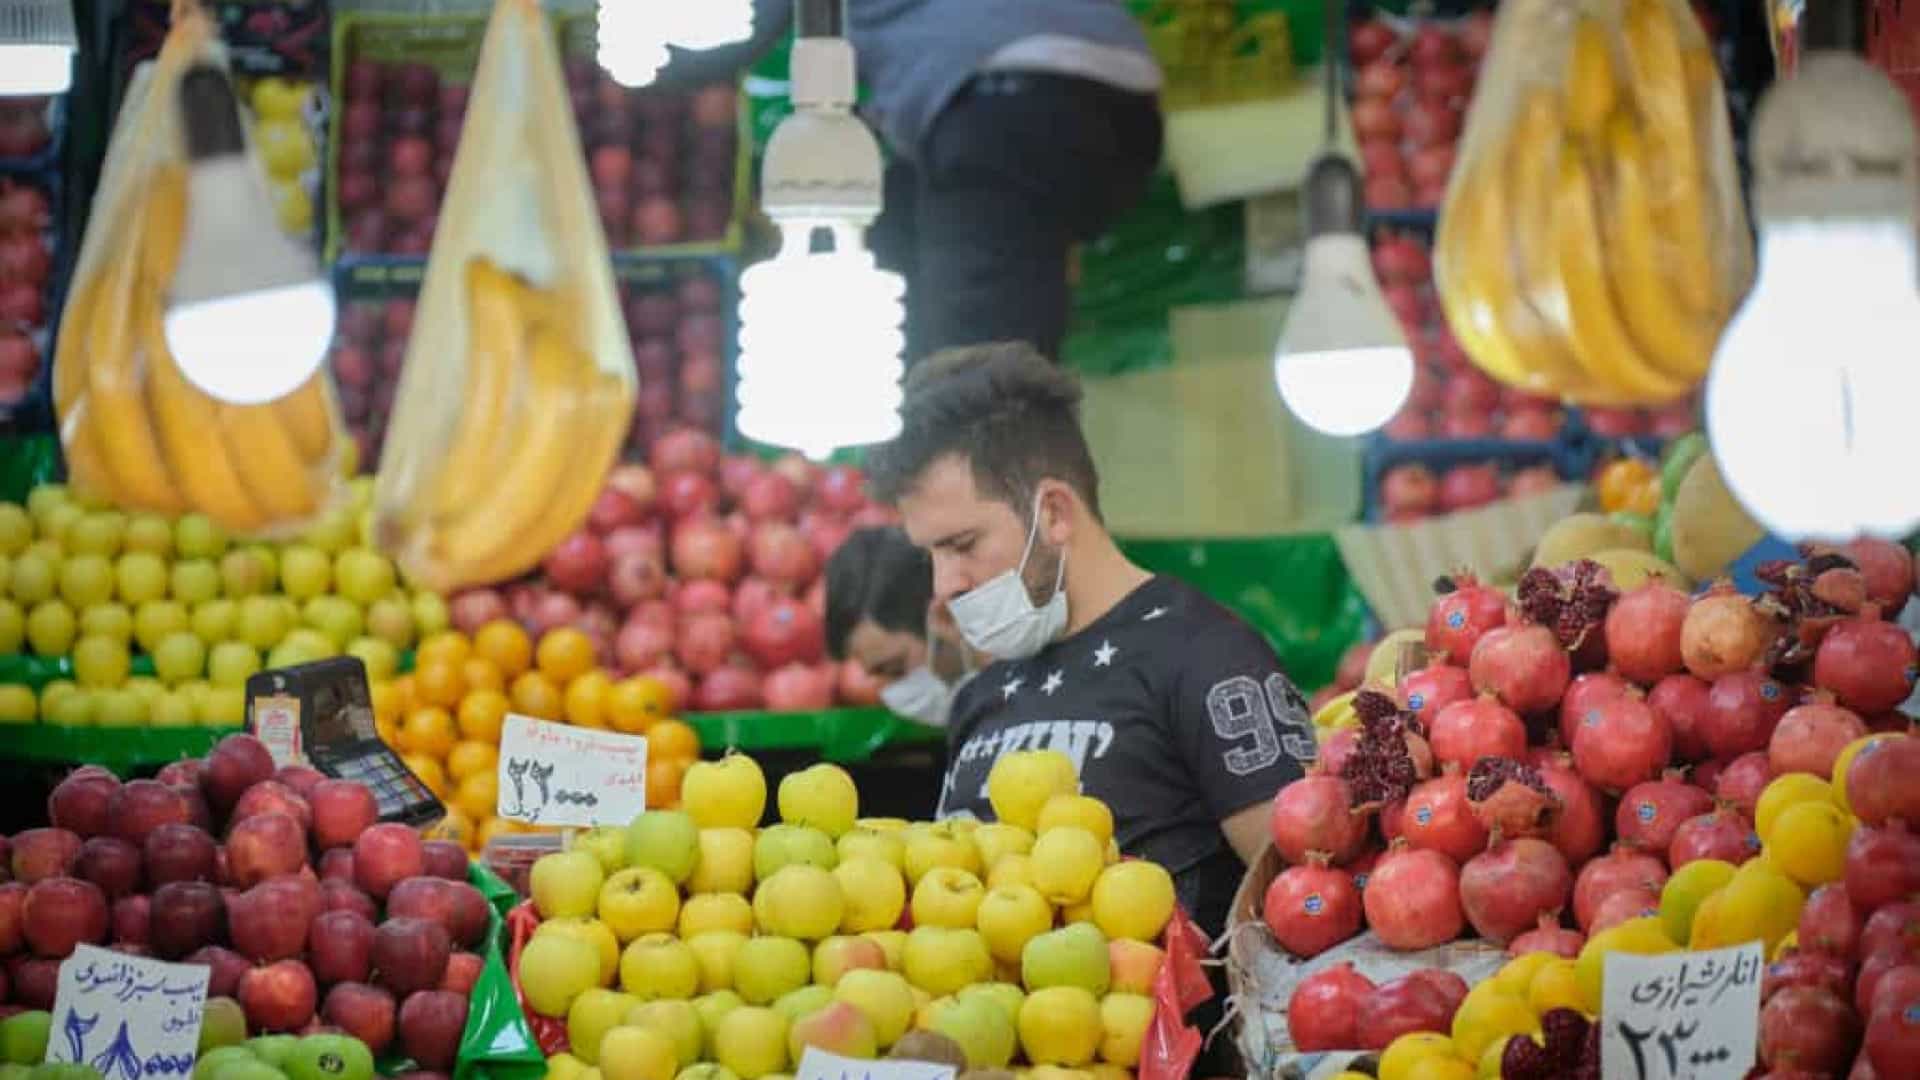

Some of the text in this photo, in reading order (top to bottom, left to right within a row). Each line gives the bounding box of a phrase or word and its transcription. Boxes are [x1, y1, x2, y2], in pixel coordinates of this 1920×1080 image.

[1206, 673, 1319, 776] 99
[1630, 949, 1759, 1011] انار شیرازی
